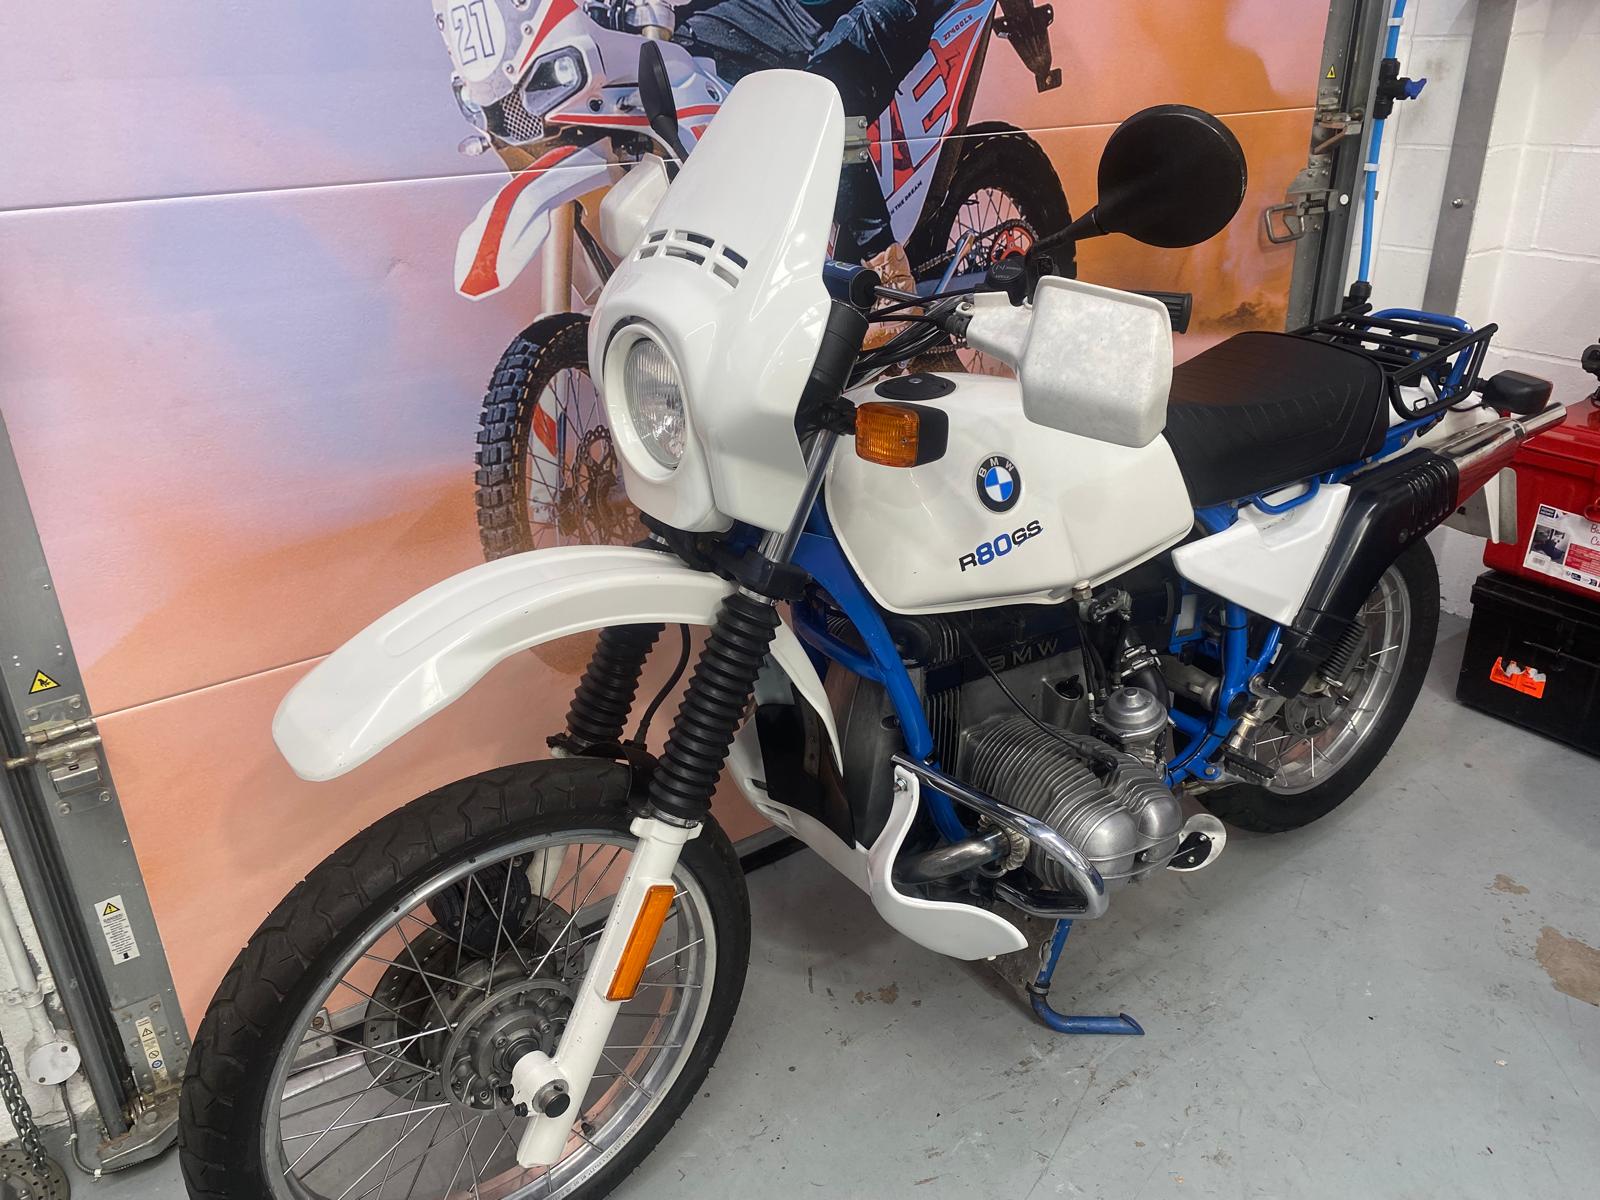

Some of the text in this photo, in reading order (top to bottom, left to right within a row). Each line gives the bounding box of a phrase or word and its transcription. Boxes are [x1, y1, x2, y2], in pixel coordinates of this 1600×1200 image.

[451, 0, 495, 66] 21
[894, 199, 904, 210] THE
[904, 180, 922, 201] DREAM
[979, 457, 1015, 478] BMW
[958, 519, 1043, 572] R80GS
[986, 638, 1058, 671] BMW
